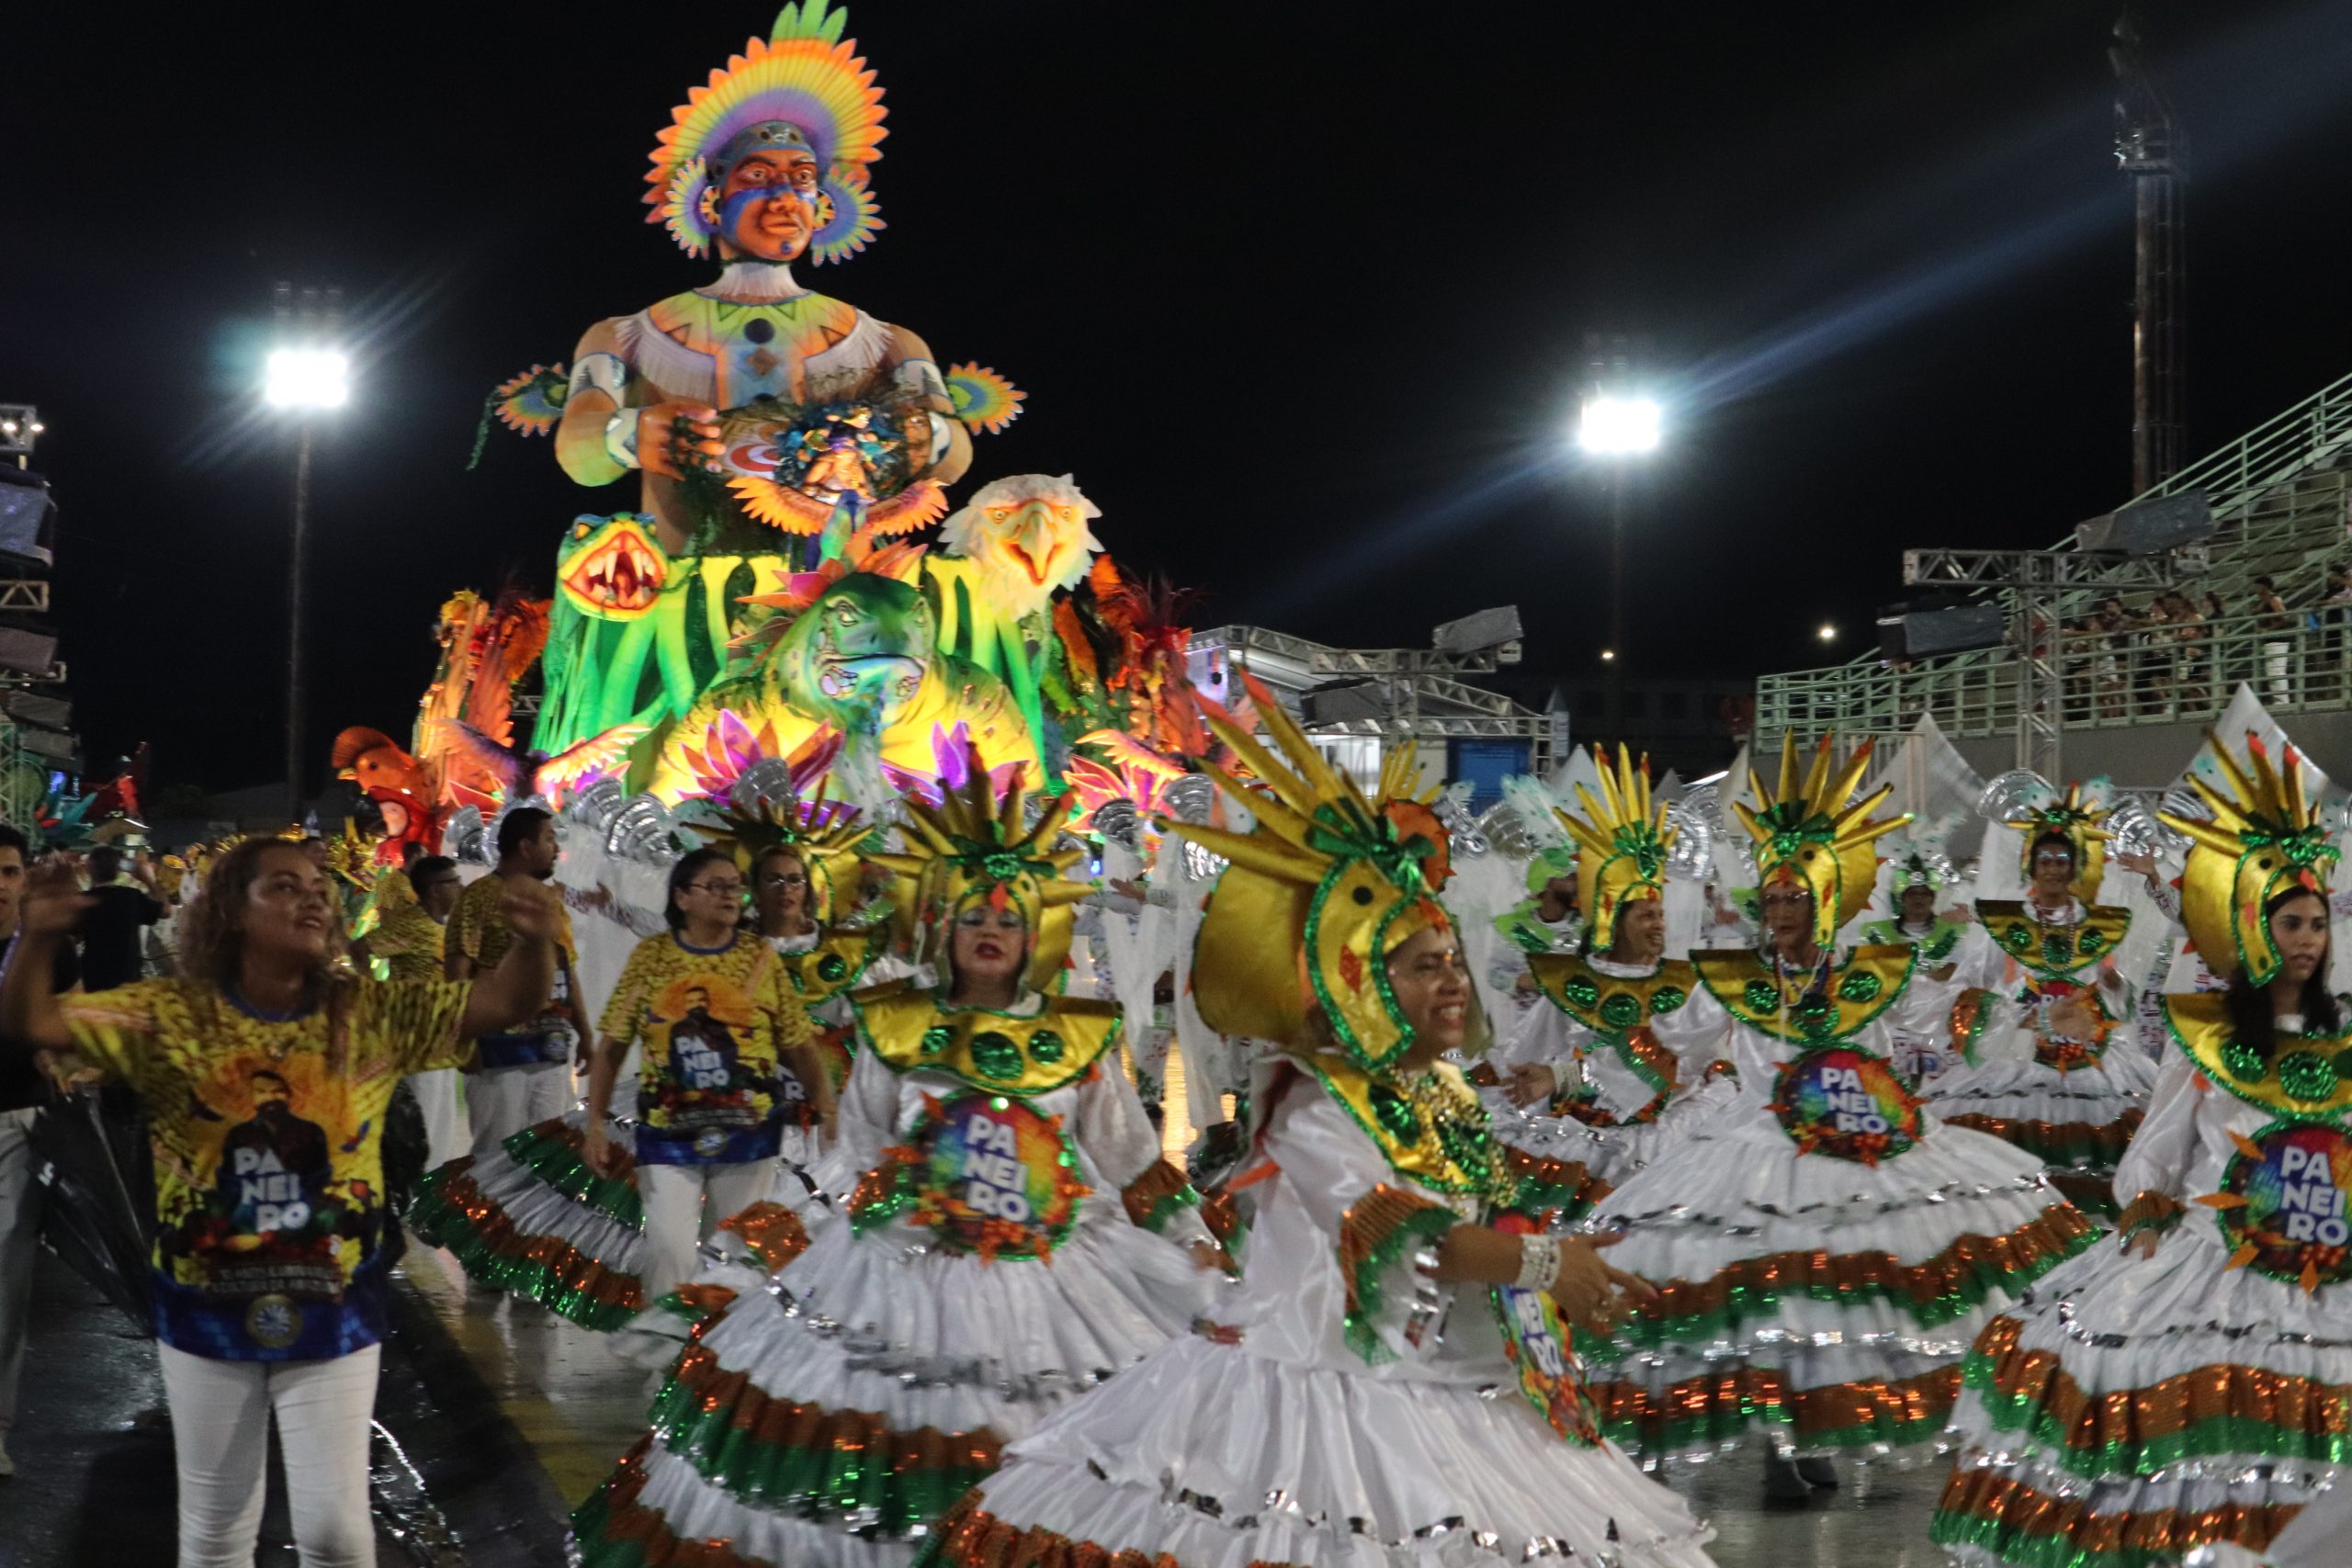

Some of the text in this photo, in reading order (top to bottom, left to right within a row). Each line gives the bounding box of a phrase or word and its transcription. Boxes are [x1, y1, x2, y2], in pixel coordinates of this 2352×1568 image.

[1820, 1066, 1864, 1093] PA
[1826, 1090, 1880, 1115] NEI
[966, 1113, 1019, 1160] PA
[1836, 1111, 1889, 1134] RO
[234, 1147, 285, 1176] PA
[961, 1148, 1029, 1195] NEI
[2279, 1145, 2333, 1185] PA
[240, 1173, 301, 1204] NEI
[967, 1179, 1031, 1223] RO
[2280, 1180, 2346, 1218] NEI
[2286, 1211, 2349, 1247] RO
